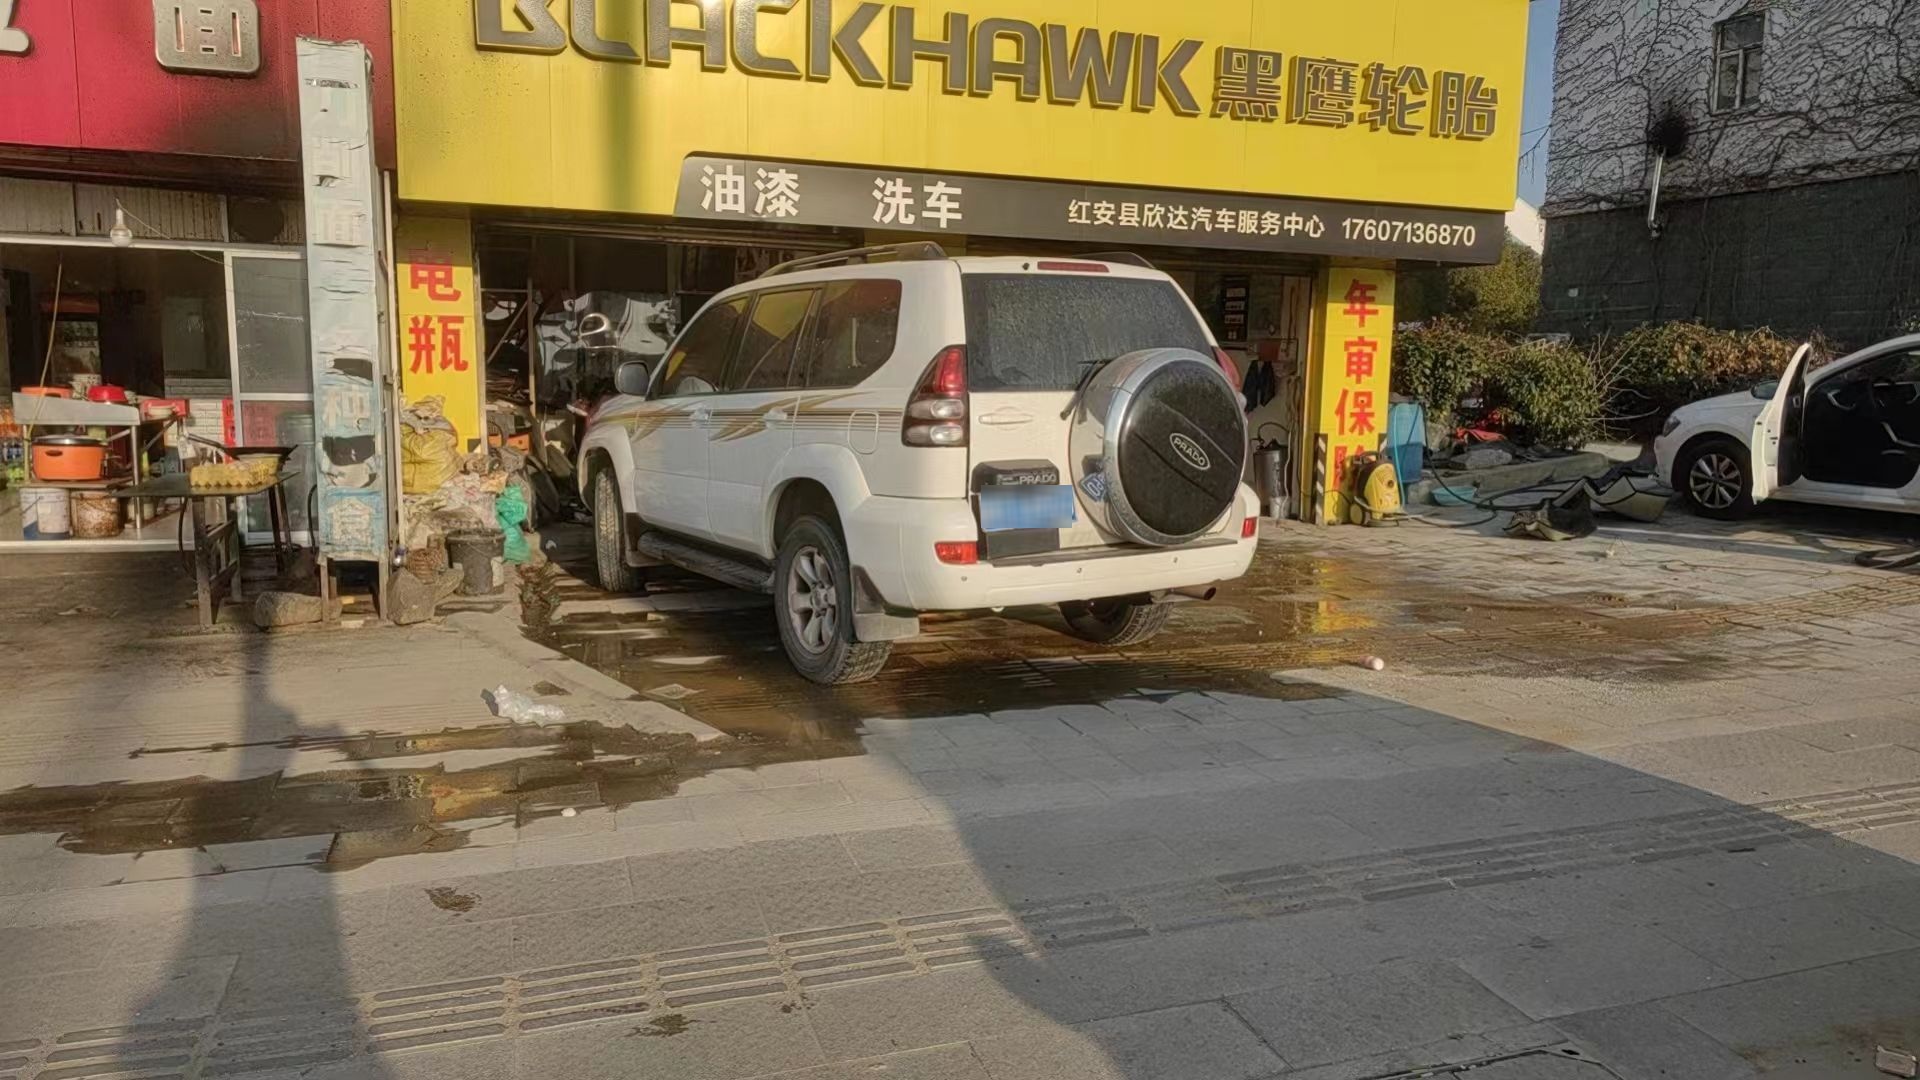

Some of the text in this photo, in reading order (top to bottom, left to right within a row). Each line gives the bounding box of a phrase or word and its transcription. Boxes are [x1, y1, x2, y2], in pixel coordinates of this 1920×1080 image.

[475, 0, 1204, 117] BLACKHAWK
[1210, 45, 1499, 140] 黑鹰轮胎
[699, 164, 963, 229] 油漆 洗车
[1067, 199, 1477, 247] 红安县欣达汽车服务中心 17607136870
[408, 240, 469, 375] 电瓶
[1019, 473, 1058, 485] PRADO
[1173, 437, 1206, 466] PRADO
